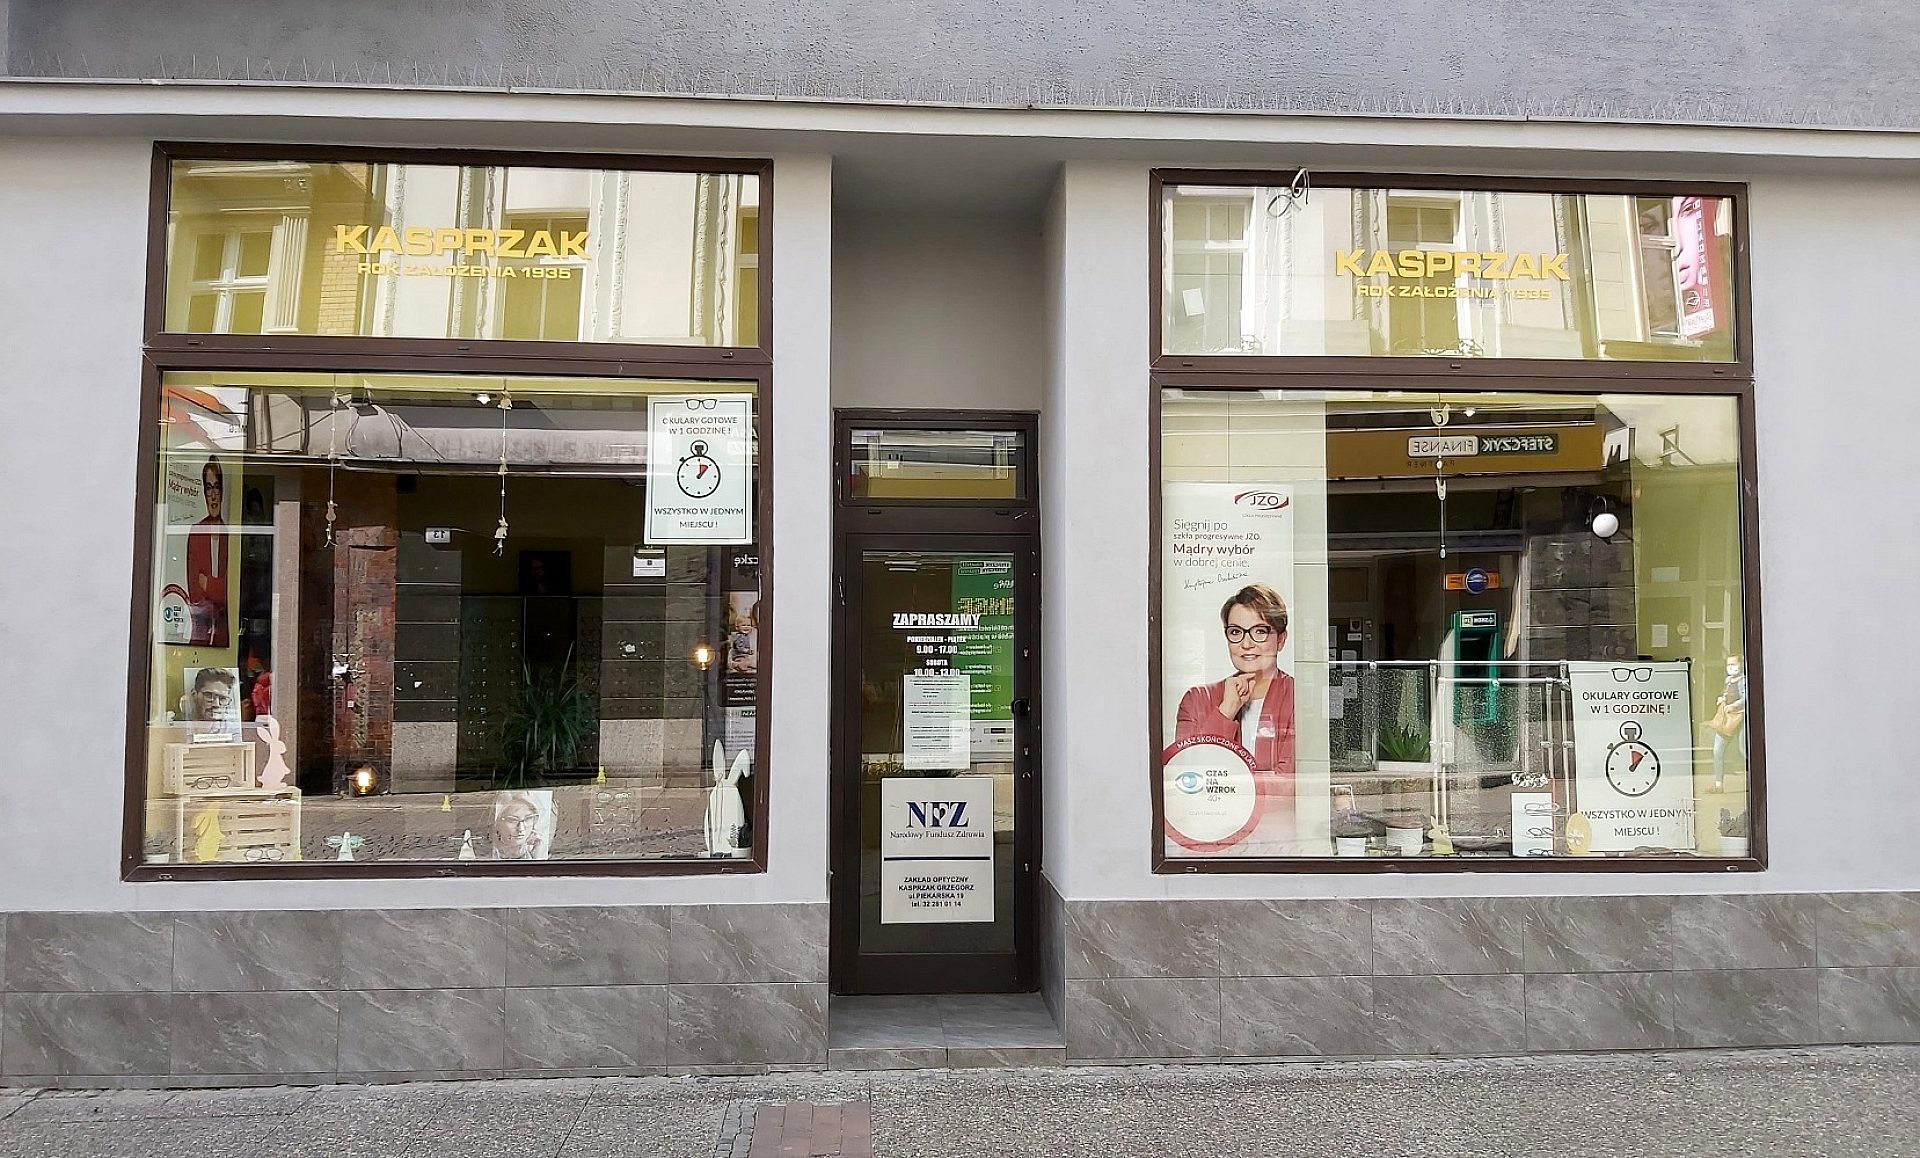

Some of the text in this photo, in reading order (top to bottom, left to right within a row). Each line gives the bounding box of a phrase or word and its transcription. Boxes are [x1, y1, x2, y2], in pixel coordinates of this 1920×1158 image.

[334, 224, 592, 261] KASPRZAK
[357, 261, 572, 280] ROK ZAŁOŻENIA 1935
[1336, 249, 1571, 281] KASPRZAK
[1356, 282, 1553, 300] ROK ZAŁOŻENIA 1935
[662, 416, 738, 425] OKULARY GOTOWE
[669, 427, 678, 436] W
[1250, 495, 1279, 506] JZO
[654, 507, 744, 516] WSZYSTKO W JEDNYM
[679, 520, 714, 529] MIEJSCU
[1174, 518, 1228, 533] Sięgnij po
[1173, 532, 1193, 541] szkła
[1195, 533, 1244, 542] progresywne
[1173, 543, 1256, 557] Mądry wybór
[1173, 557, 1250, 569] w dobrej cenie.
[892, 612, 981, 627] ZAPRASZAMY
[916, 645, 934, 655] 9.00
[939, 645, 958, 655] 17.00
[926, 658, 948, 667] SOBOTA
[914, 667, 935, 678] 10.00
[940, 667, 960, 678] 13.00
[1582, 690, 1680, 701] OKULARY GOTOWE
[1590, 704, 1601, 714] W
[1612, 703, 1665, 716] GODZINĘ
[1205, 778, 1219, 786] NA
[1205, 785, 1236, 794] WZROK
[906, 801, 970, 829] NFZ
[1581, 809, 1635, 820] WSZYSTKO
[1636, 809, 1647, 818] W
[890, 830, 985, 839] Narodowy Fundusz Zdrowia
[1614, 827, 1655, 837] MIEJSCU
